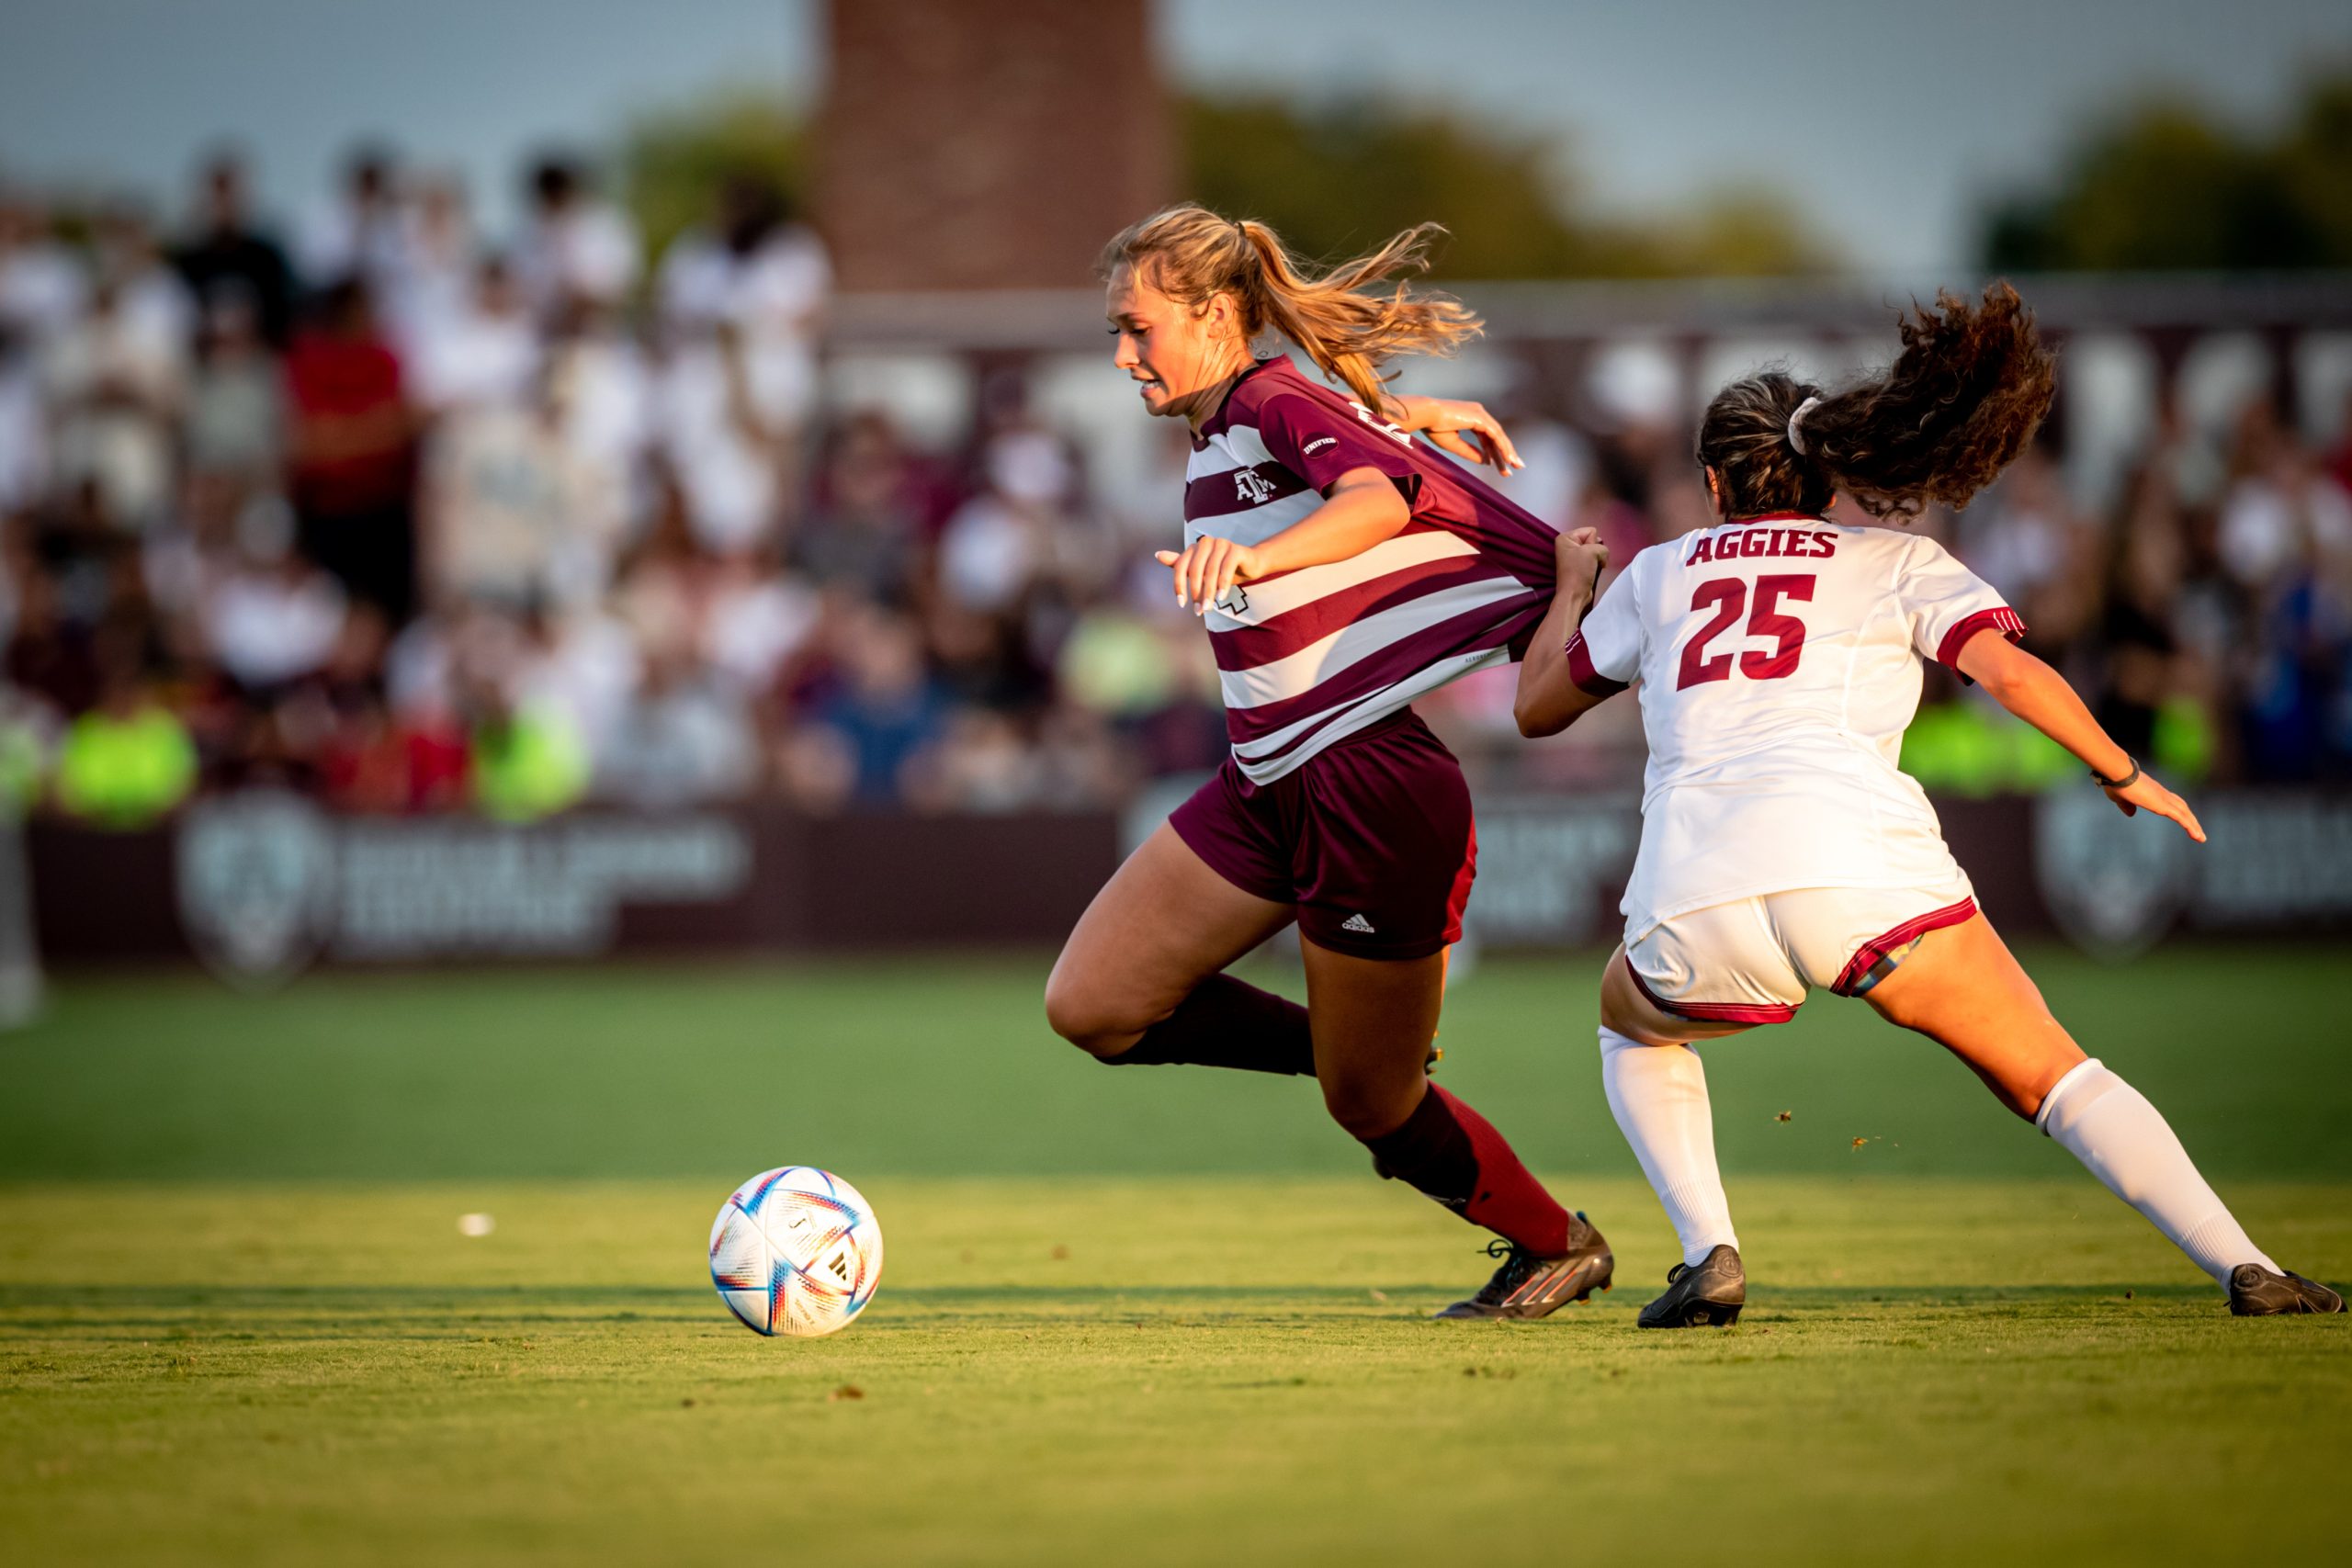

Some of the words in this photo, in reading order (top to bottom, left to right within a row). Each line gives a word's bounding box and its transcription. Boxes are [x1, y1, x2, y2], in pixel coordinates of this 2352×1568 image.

[1303, 437, 1337, 455] UNIFIED
[1686, 528, 1838, 567] AGGIES
[1676, 573, 1816, 692] 25
[1341, 922, 1375, 933] adidas
